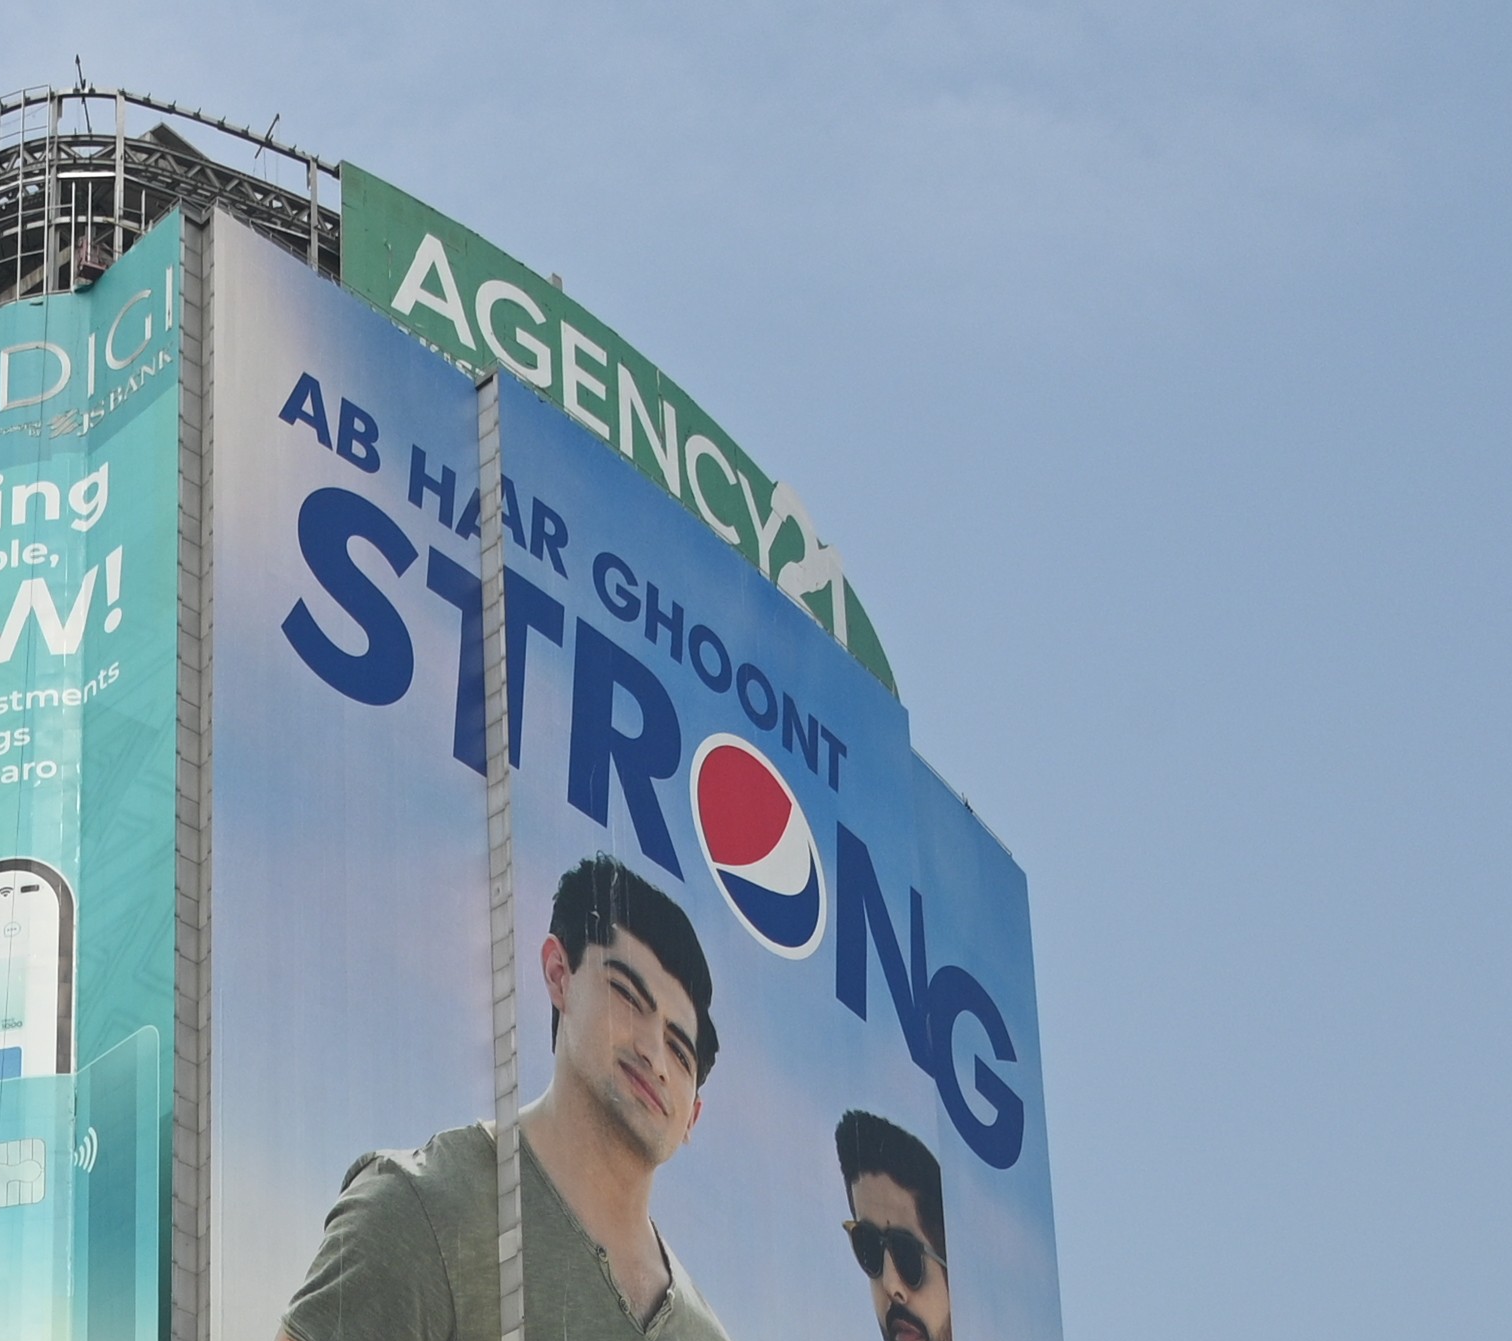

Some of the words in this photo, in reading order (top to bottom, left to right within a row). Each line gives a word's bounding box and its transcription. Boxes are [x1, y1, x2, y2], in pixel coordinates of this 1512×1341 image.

[107, 342, 173, 413] BANK
[279, 372, 381, 475] AB
[407, 443, 570, 580] HAR
[592, 551, 848, 793] GHOONT
